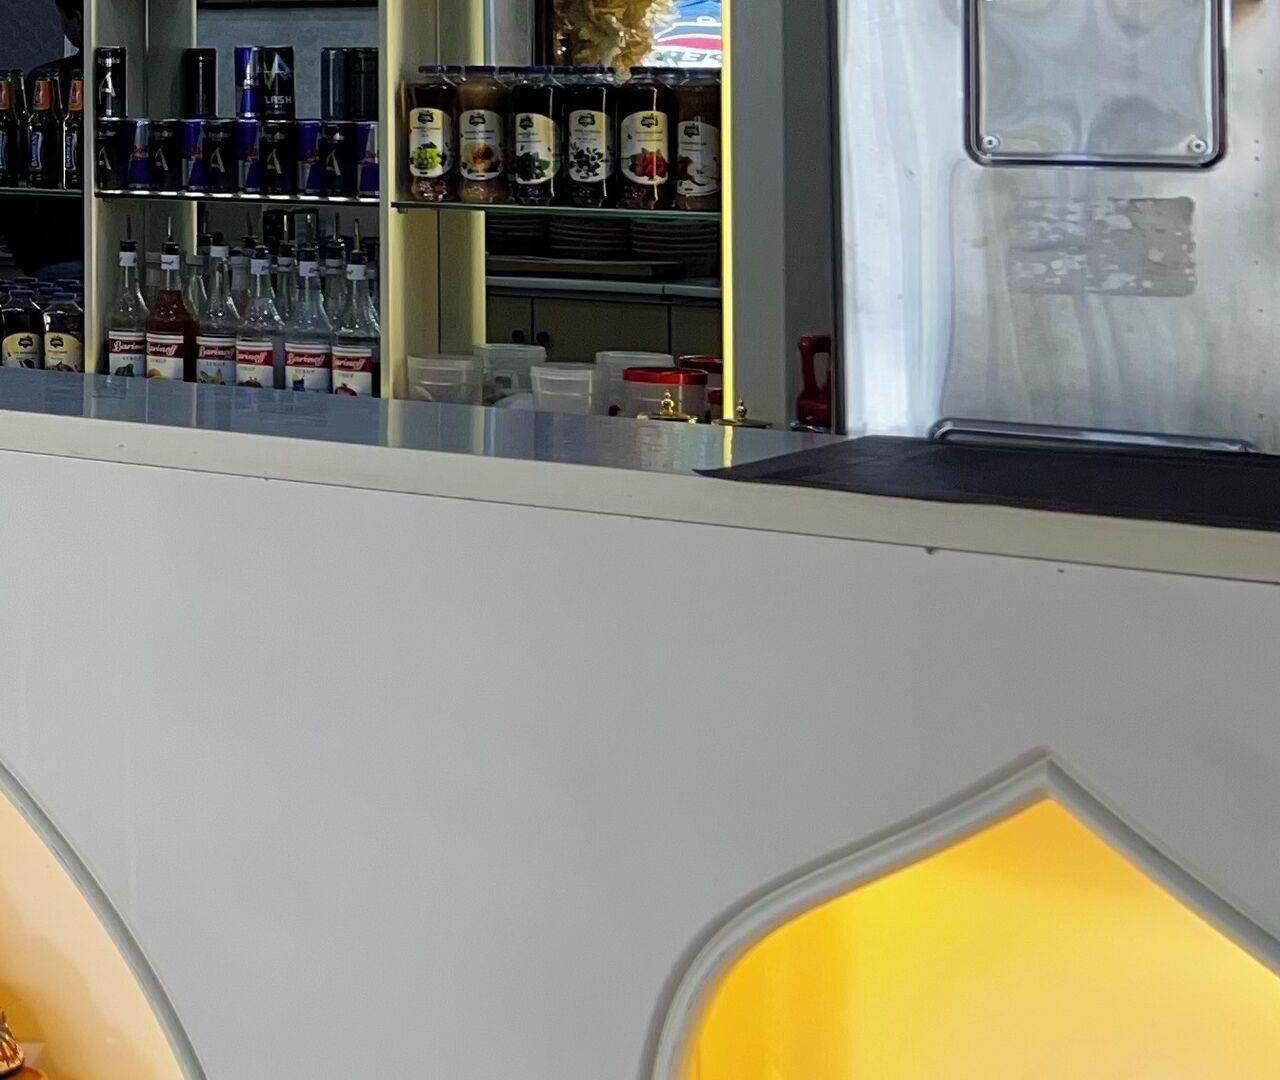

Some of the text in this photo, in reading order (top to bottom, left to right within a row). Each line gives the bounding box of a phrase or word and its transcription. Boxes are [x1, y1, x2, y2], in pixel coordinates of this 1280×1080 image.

[264, 95, 292, 104] LASH
[147, 344, 179, 356] arinoff
[236, 351, 267, 364] arinoff
[334, 358, 366, 370] arinoff
